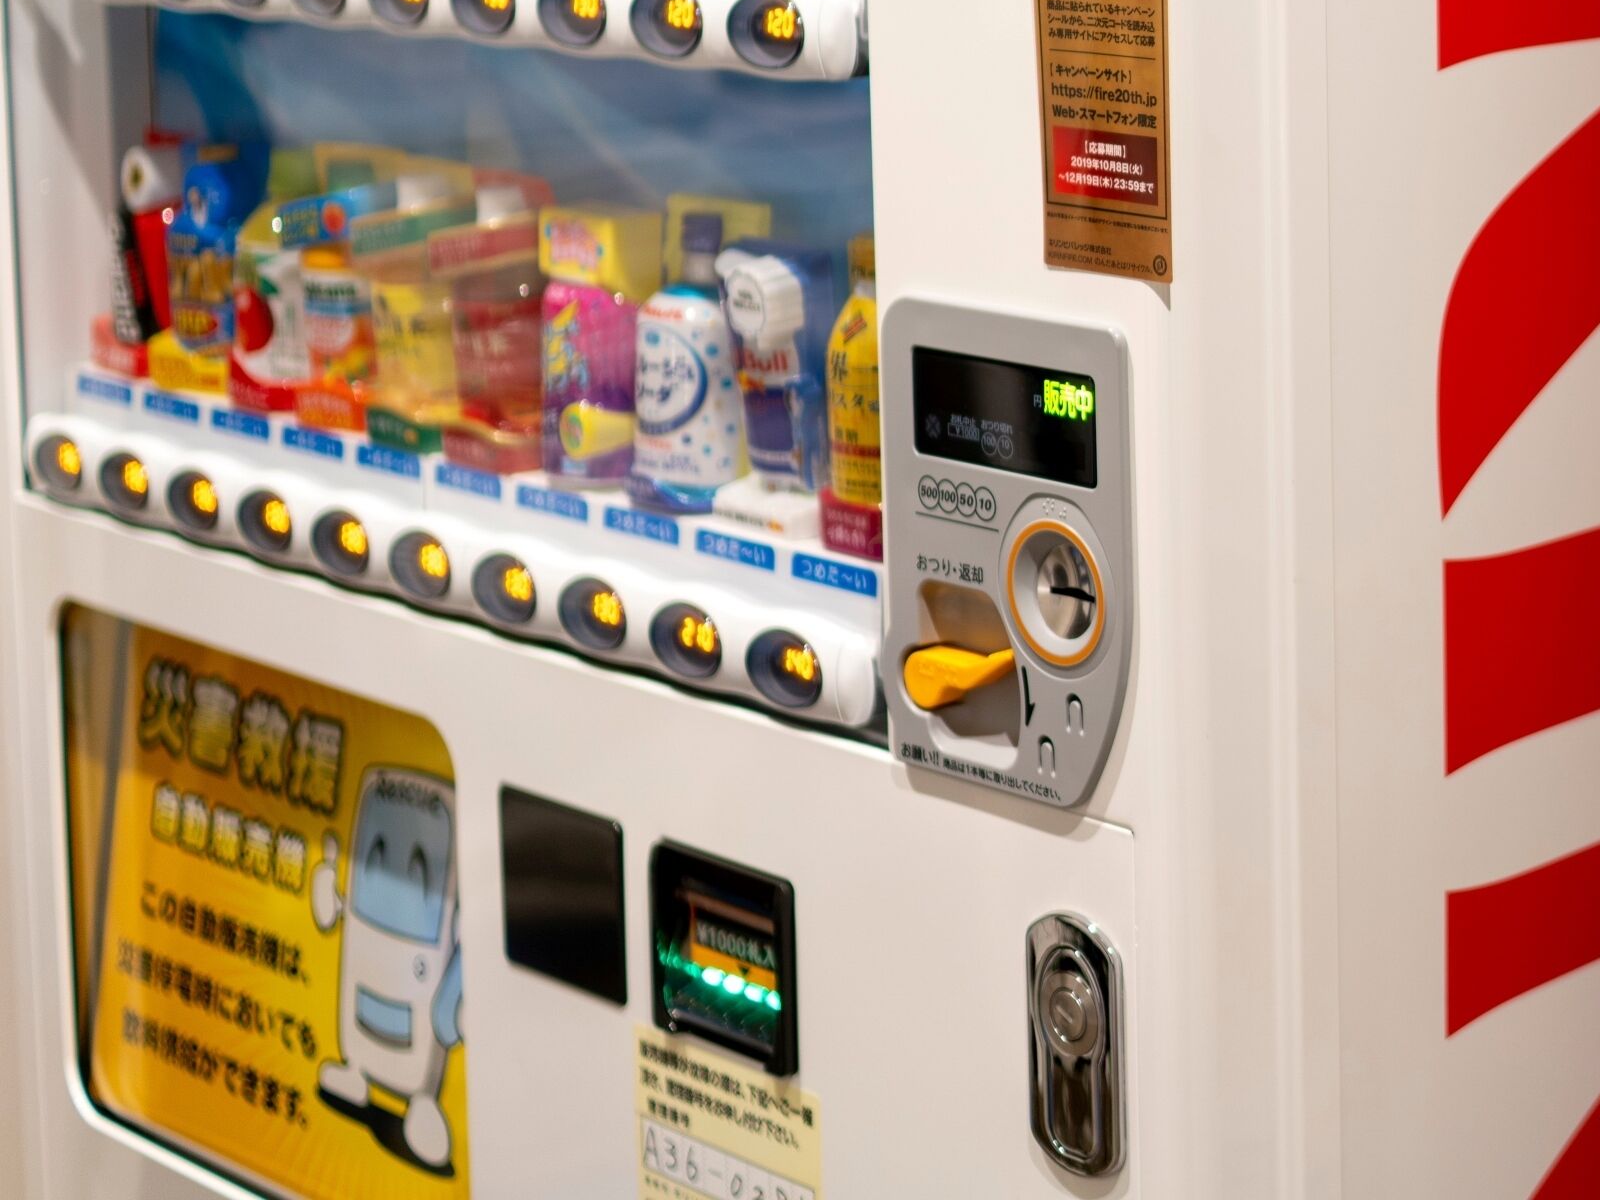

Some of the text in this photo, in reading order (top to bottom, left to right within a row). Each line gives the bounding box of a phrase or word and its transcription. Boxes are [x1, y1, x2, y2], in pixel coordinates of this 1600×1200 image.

[766, 7, 796, 39] 120
[1051, 82, 1157, 107] https://fire20th.jp
[1043, 378, 1094, 421] 販売中
[920, 485, 992, 511] 500 100 50 10
[916, 553, 984, 584] おつり・返却
[680, 616, 717, 653] 210
[784, 648, 815, 681] 140
[137, 656, 346, 818] 災害救援
[151, 779, 307, 896] 自動販売機
